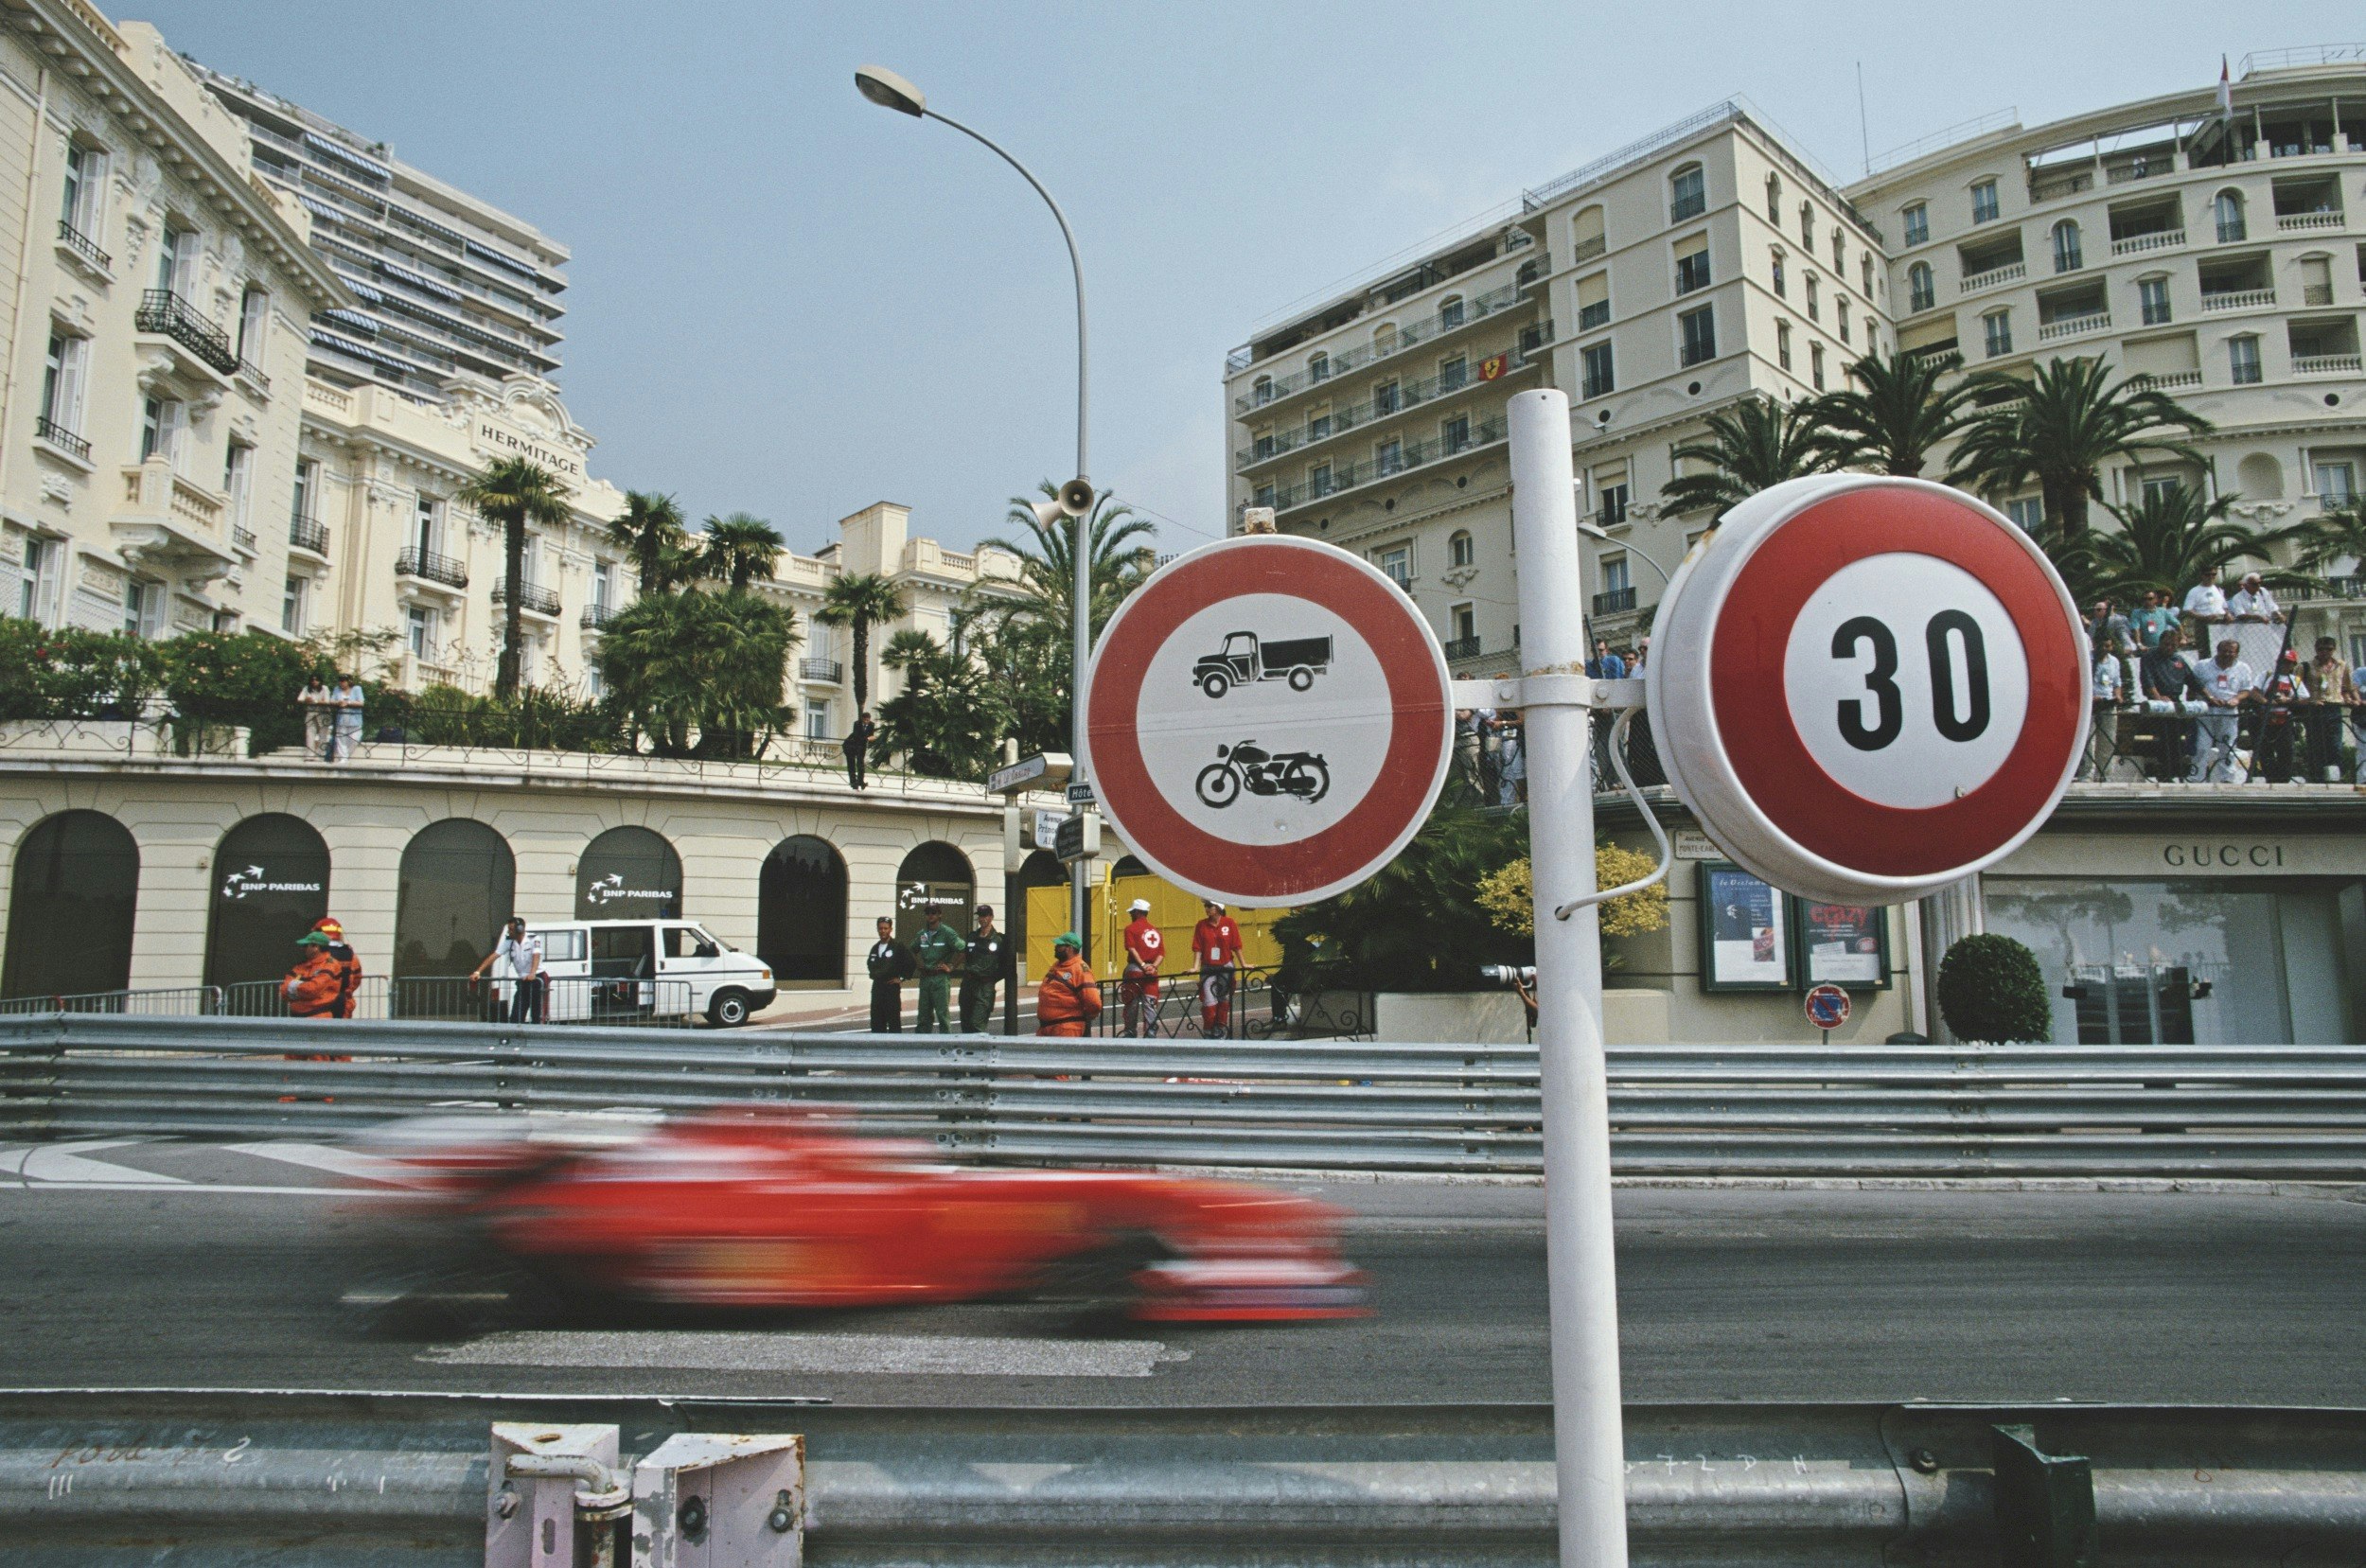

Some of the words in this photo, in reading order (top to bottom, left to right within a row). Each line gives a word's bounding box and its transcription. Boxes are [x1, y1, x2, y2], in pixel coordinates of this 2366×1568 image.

[482, 424, 579, 476] HERMITAGE
[1831, 608, 1991, 751] 30
[1071, 786, 1093, 799] Hôte
[1037, 823, 1058, 834] Princ
[2163, 844, 2284, 867] GUCCI
[268, 883, 321, 891] PARIBAS
